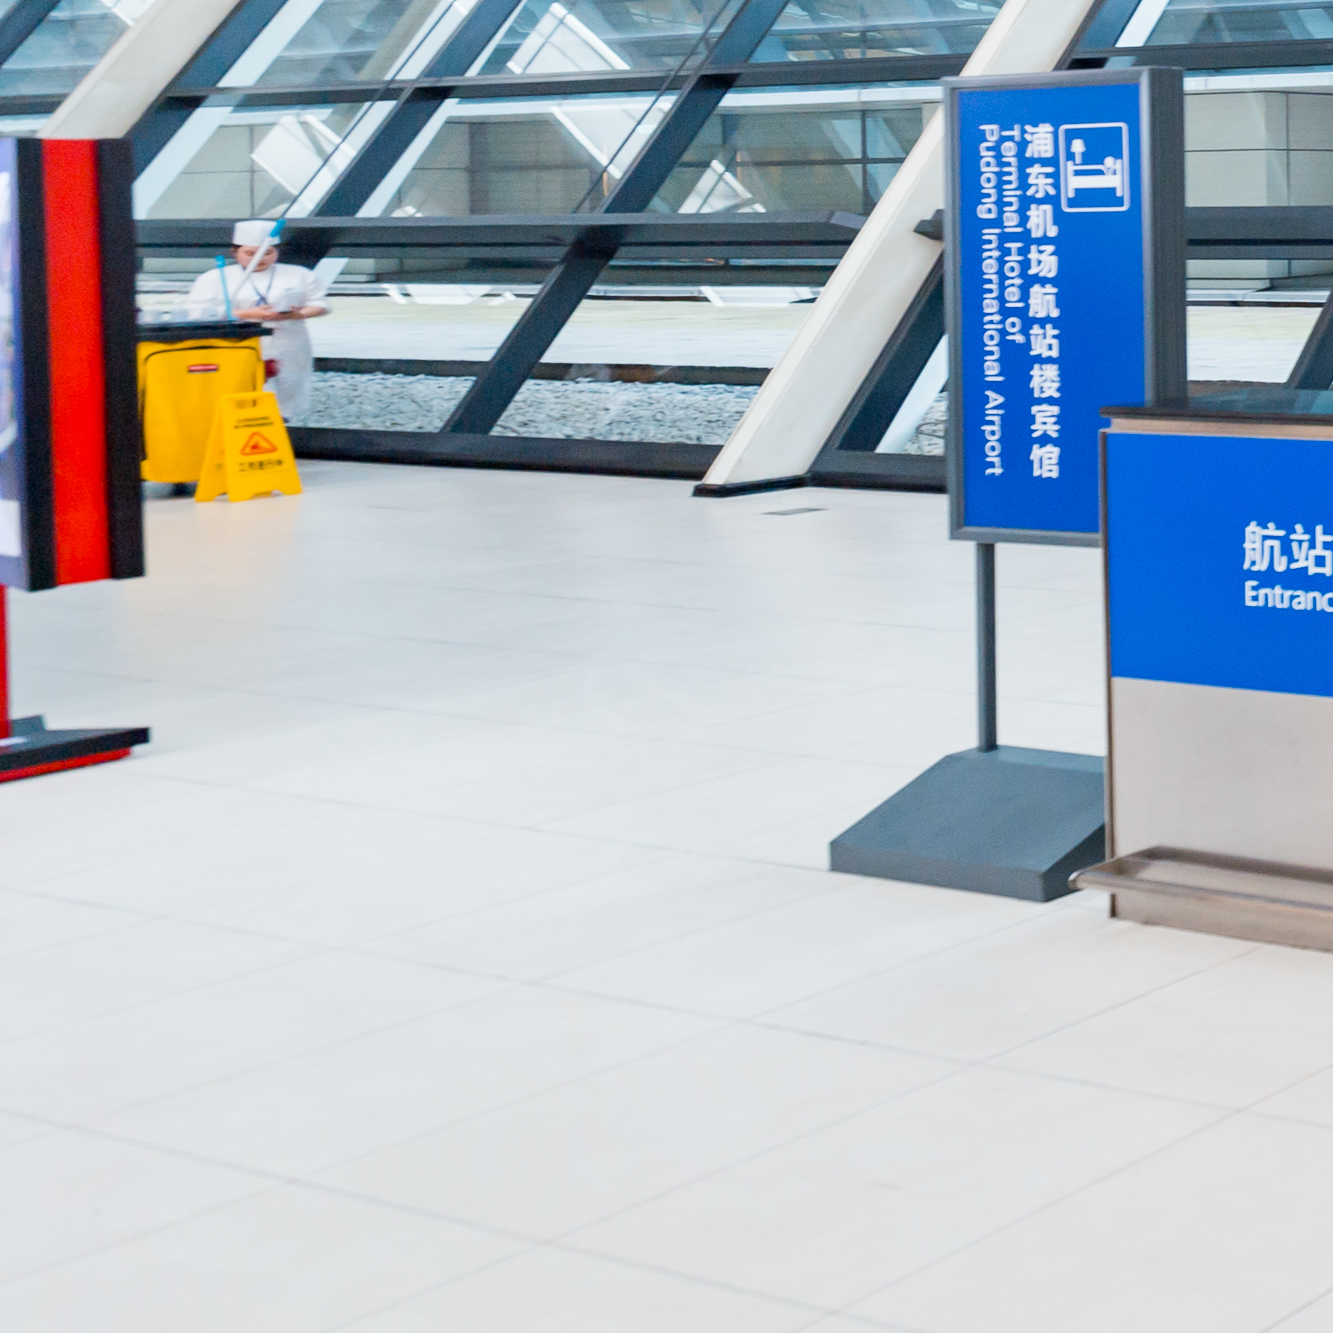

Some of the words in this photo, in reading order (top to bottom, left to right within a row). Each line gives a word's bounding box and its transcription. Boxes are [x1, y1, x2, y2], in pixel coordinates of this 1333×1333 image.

[977, 124, 1000, 219] Pudong
[1001, 124, 1024, 232] Terminal
[982, 229, 1005, 381] International
[1004, 243, 1025, 307] Hotel
[1024, 123, 1061, 478] 浦东机场航站楼宾馆
[1005, 317, 1025, 343] of
[981, 391, 1005, 476] Airport
